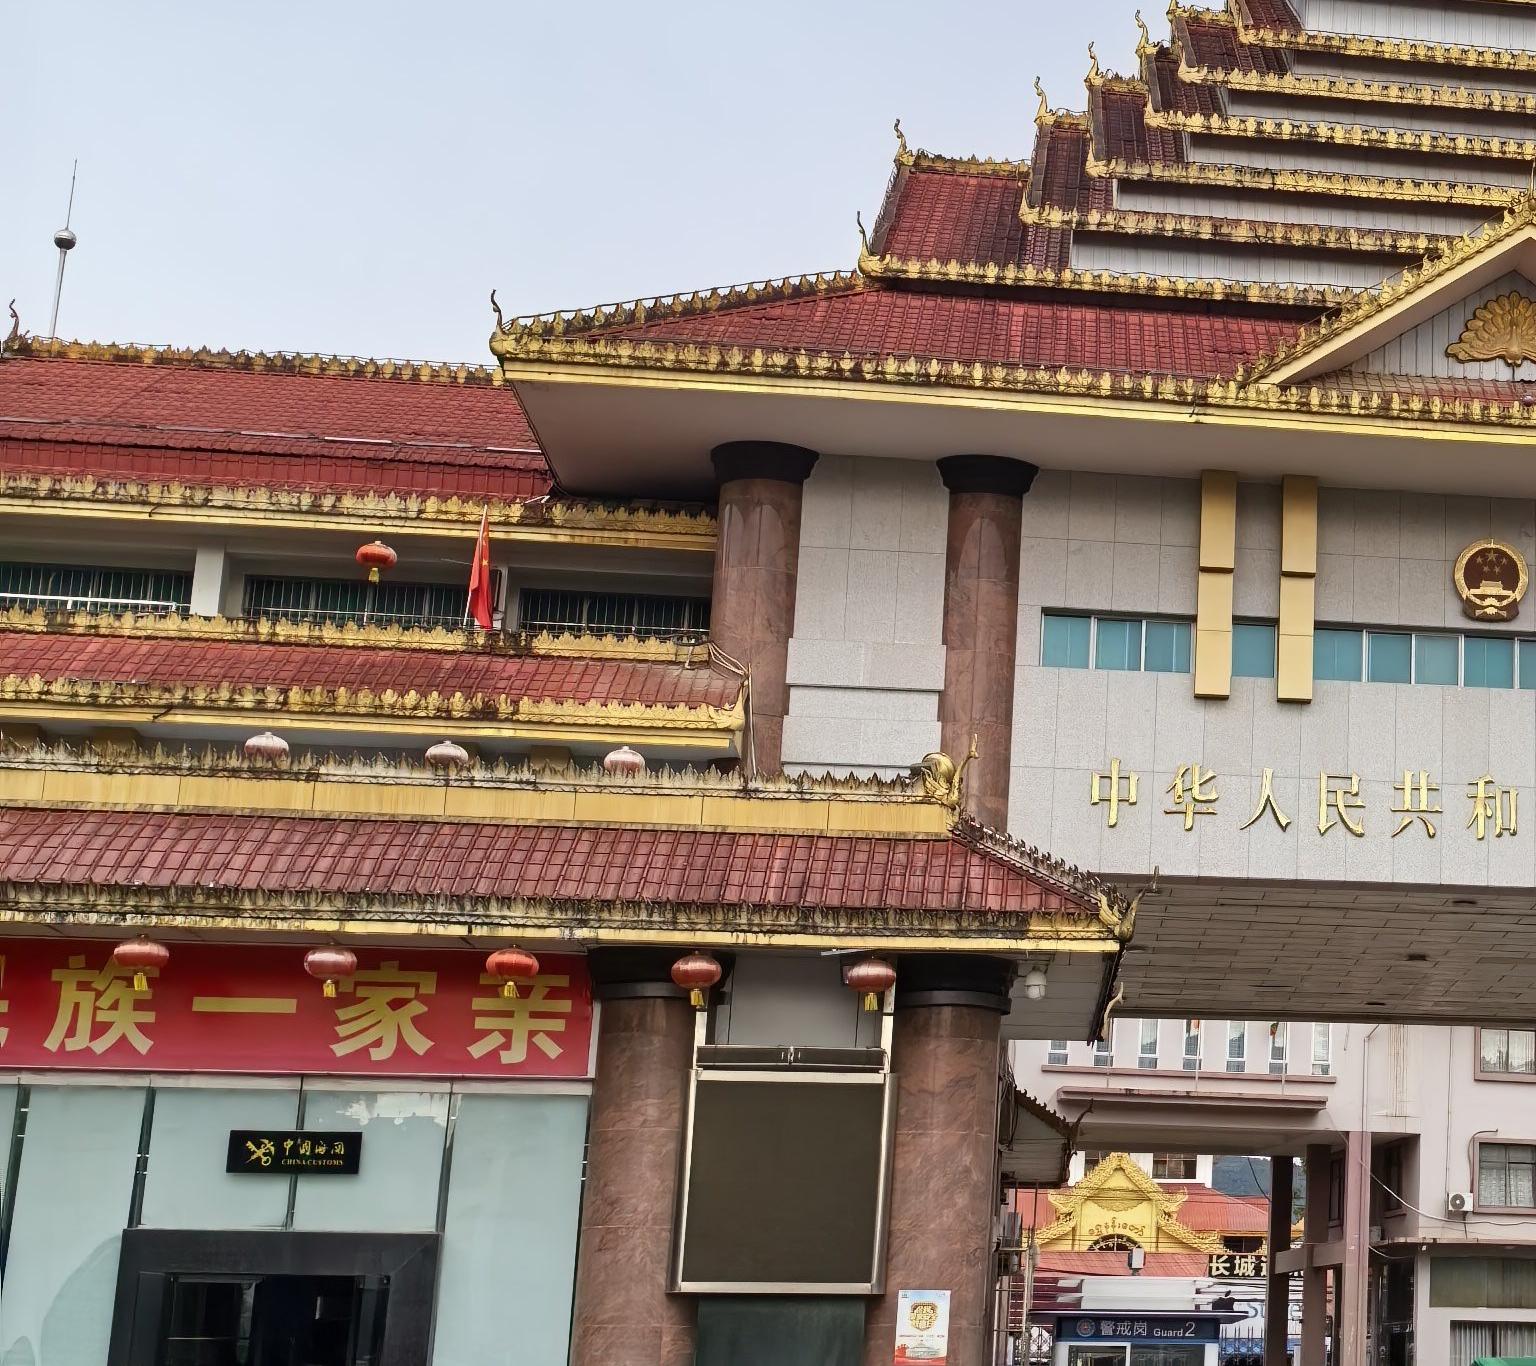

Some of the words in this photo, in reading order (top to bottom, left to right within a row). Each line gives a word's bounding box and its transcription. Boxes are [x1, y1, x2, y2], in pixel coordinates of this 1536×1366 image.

[0, 953, 573, 1065] 族一家亲
[1100, 1320, 1147, 1336] 警戒岗
[1153, 1328, 1184, 1337] Guard
